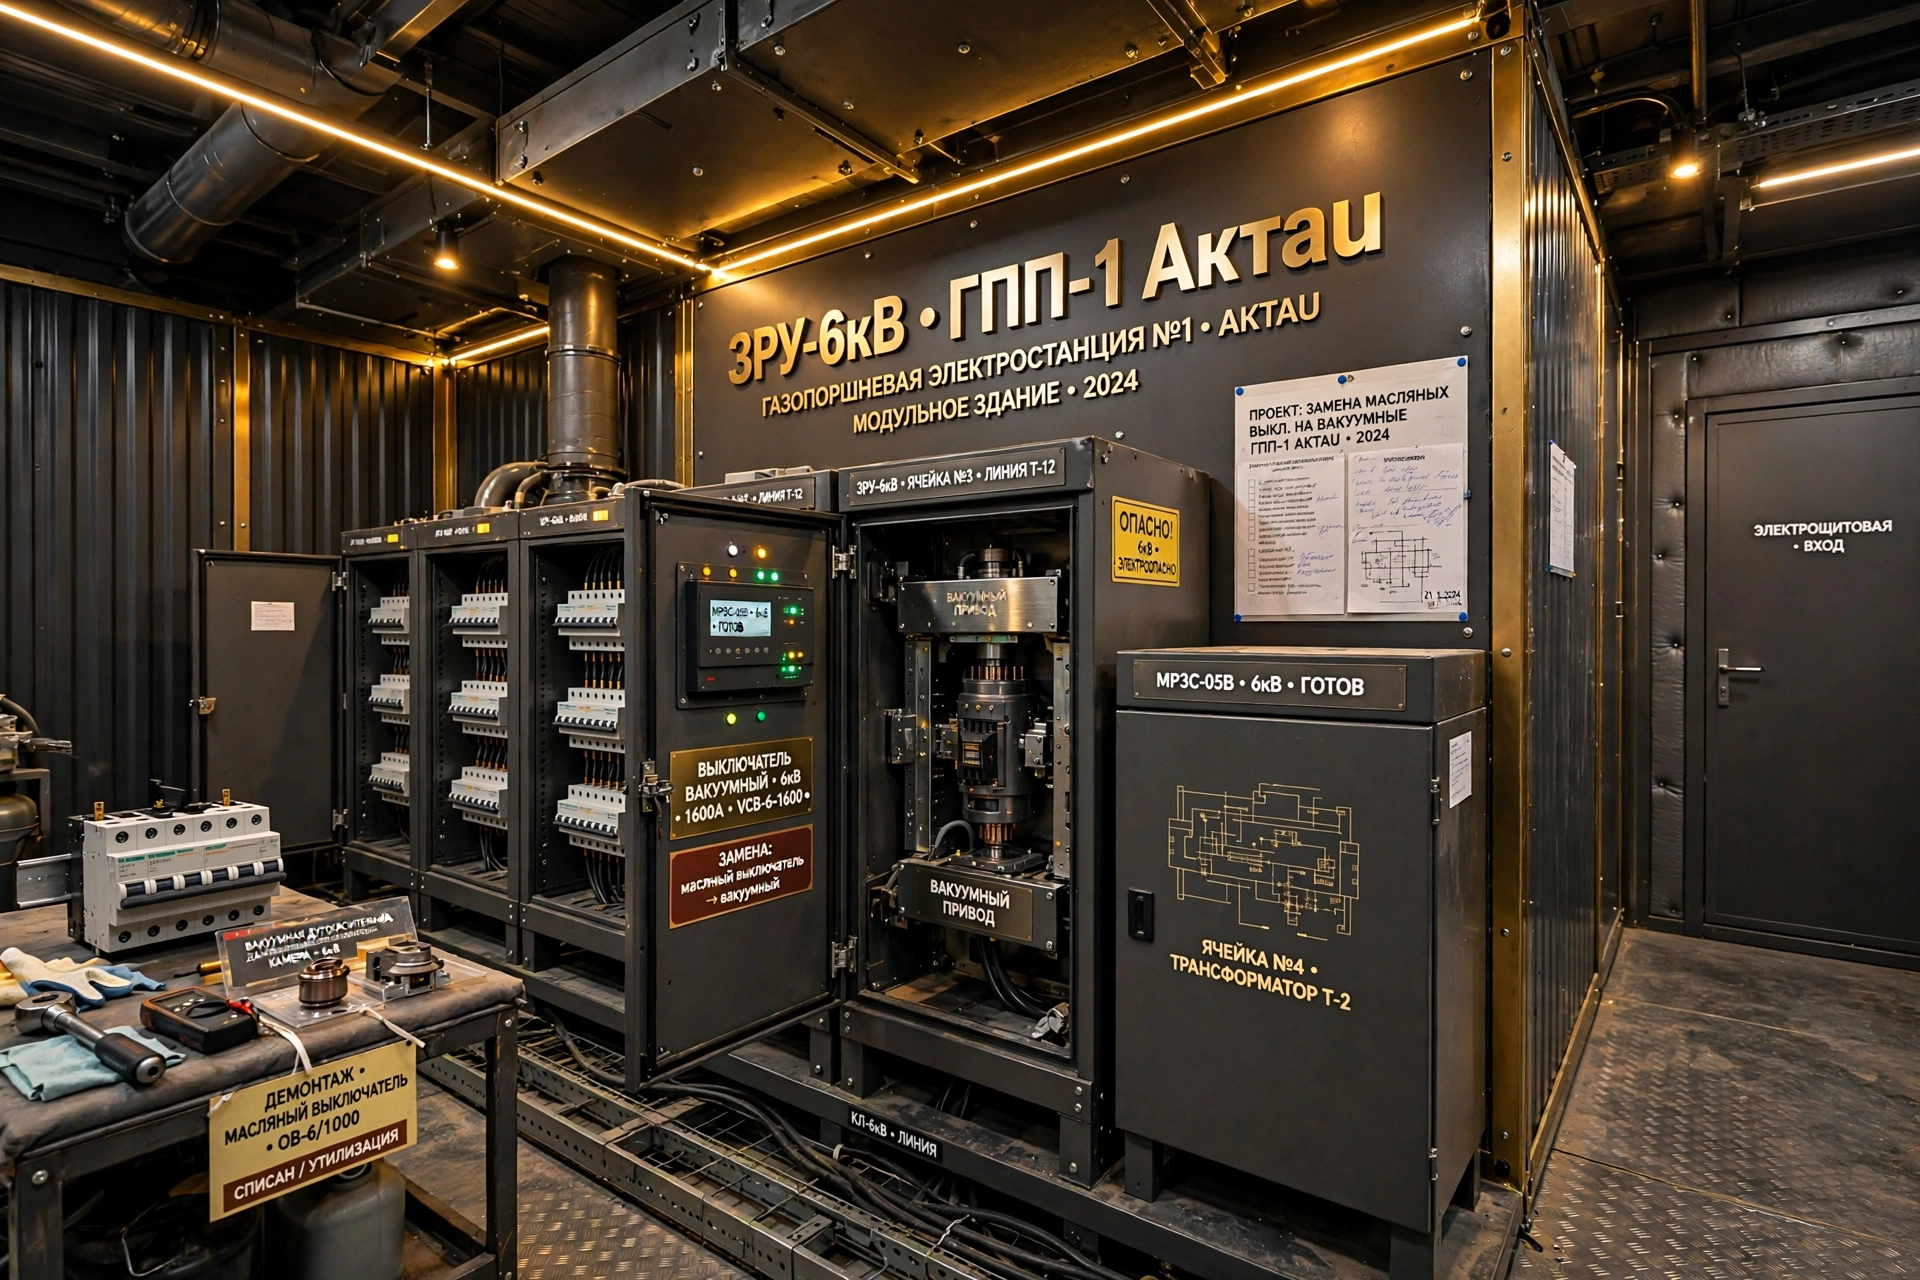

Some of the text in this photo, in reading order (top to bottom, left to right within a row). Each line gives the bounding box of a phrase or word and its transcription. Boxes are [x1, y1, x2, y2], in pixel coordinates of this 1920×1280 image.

[728, 294, 907, 386] ЗРУ-6кВ
[949, 237, 1123, 341] ГПП-1
[762, 368, 923, 418] ГАЗОПОРШНЕВАЯ
[928, 325, 1146, 388] ЭЛЕКТРОСТАНЦИЯ
[1152, 315, 1193, 349] №1
[853, 368, 1139, 434] МОДУЛЬНОЕ ЗДАНИЕ 2024
[1249, 385, 1450, 421] ПРОЕКТ: ЗАМЕНА МАСЛЯНЫХ
[1249, 408, 1408, 438] ВЫКЛ. НА ВАКУУМНЫЕ
[1251, 438, 1289, 455] ГПП-1
[1355, 428, 1391, 444] 2024
[856, 459, 1056, 496] ЗРУ-6кВ ЯЧЕЙКА №3 ЛИНИЯ Т-12
[1119, 511, 1173, 540] ОПАСНО!
[1753, 519, 1893, 537] ЭЛЕКТРОЩИТОВАЯ
[1804, 539, 1845, 553] ВХОД
[1250, 674, 1283, 693] 6кВ
[1301, 676, 1365, 696] ГОТОВ
[697, 751, 792, 778] ВЫКЛЮЧАТЕЛЬ
[685, 769, 802, 803] ВАКУУМНЫЙ 6кВ
[684, 789, 803, 824] 1600А VCB-6-1600
[718, 842, 773, 867] ЗАМЕНА:
[720, 876, 781, 905] вакуумный
[930, 879, 1011, 910] ВАКУУМНЫЙ
[943, 900, 996, 928] ПРИВОД
[1202, 939, 1305, 976] ЯЧЕЙКА №4
[1169, 953, 1351, 1011] ТРАНСФОРМАТОР Т-2
[264, 1066, 355, 1113] ДЕМОНТАЖ
[224, 1073, 409, 1146] МАСЛЯНЫЙ ВЫКЛЮЧАТЕЛЬ
[277, 1109, 360, 1151] ОВ-6/1000
[851, 1110, 937, 1158] КЛ-6кВ ЛИНИЯ
[233, 1166, 295, 1200] СПИСАН
[308, 1127, 399, 1173] УТИЛИЗАЦИЯ
